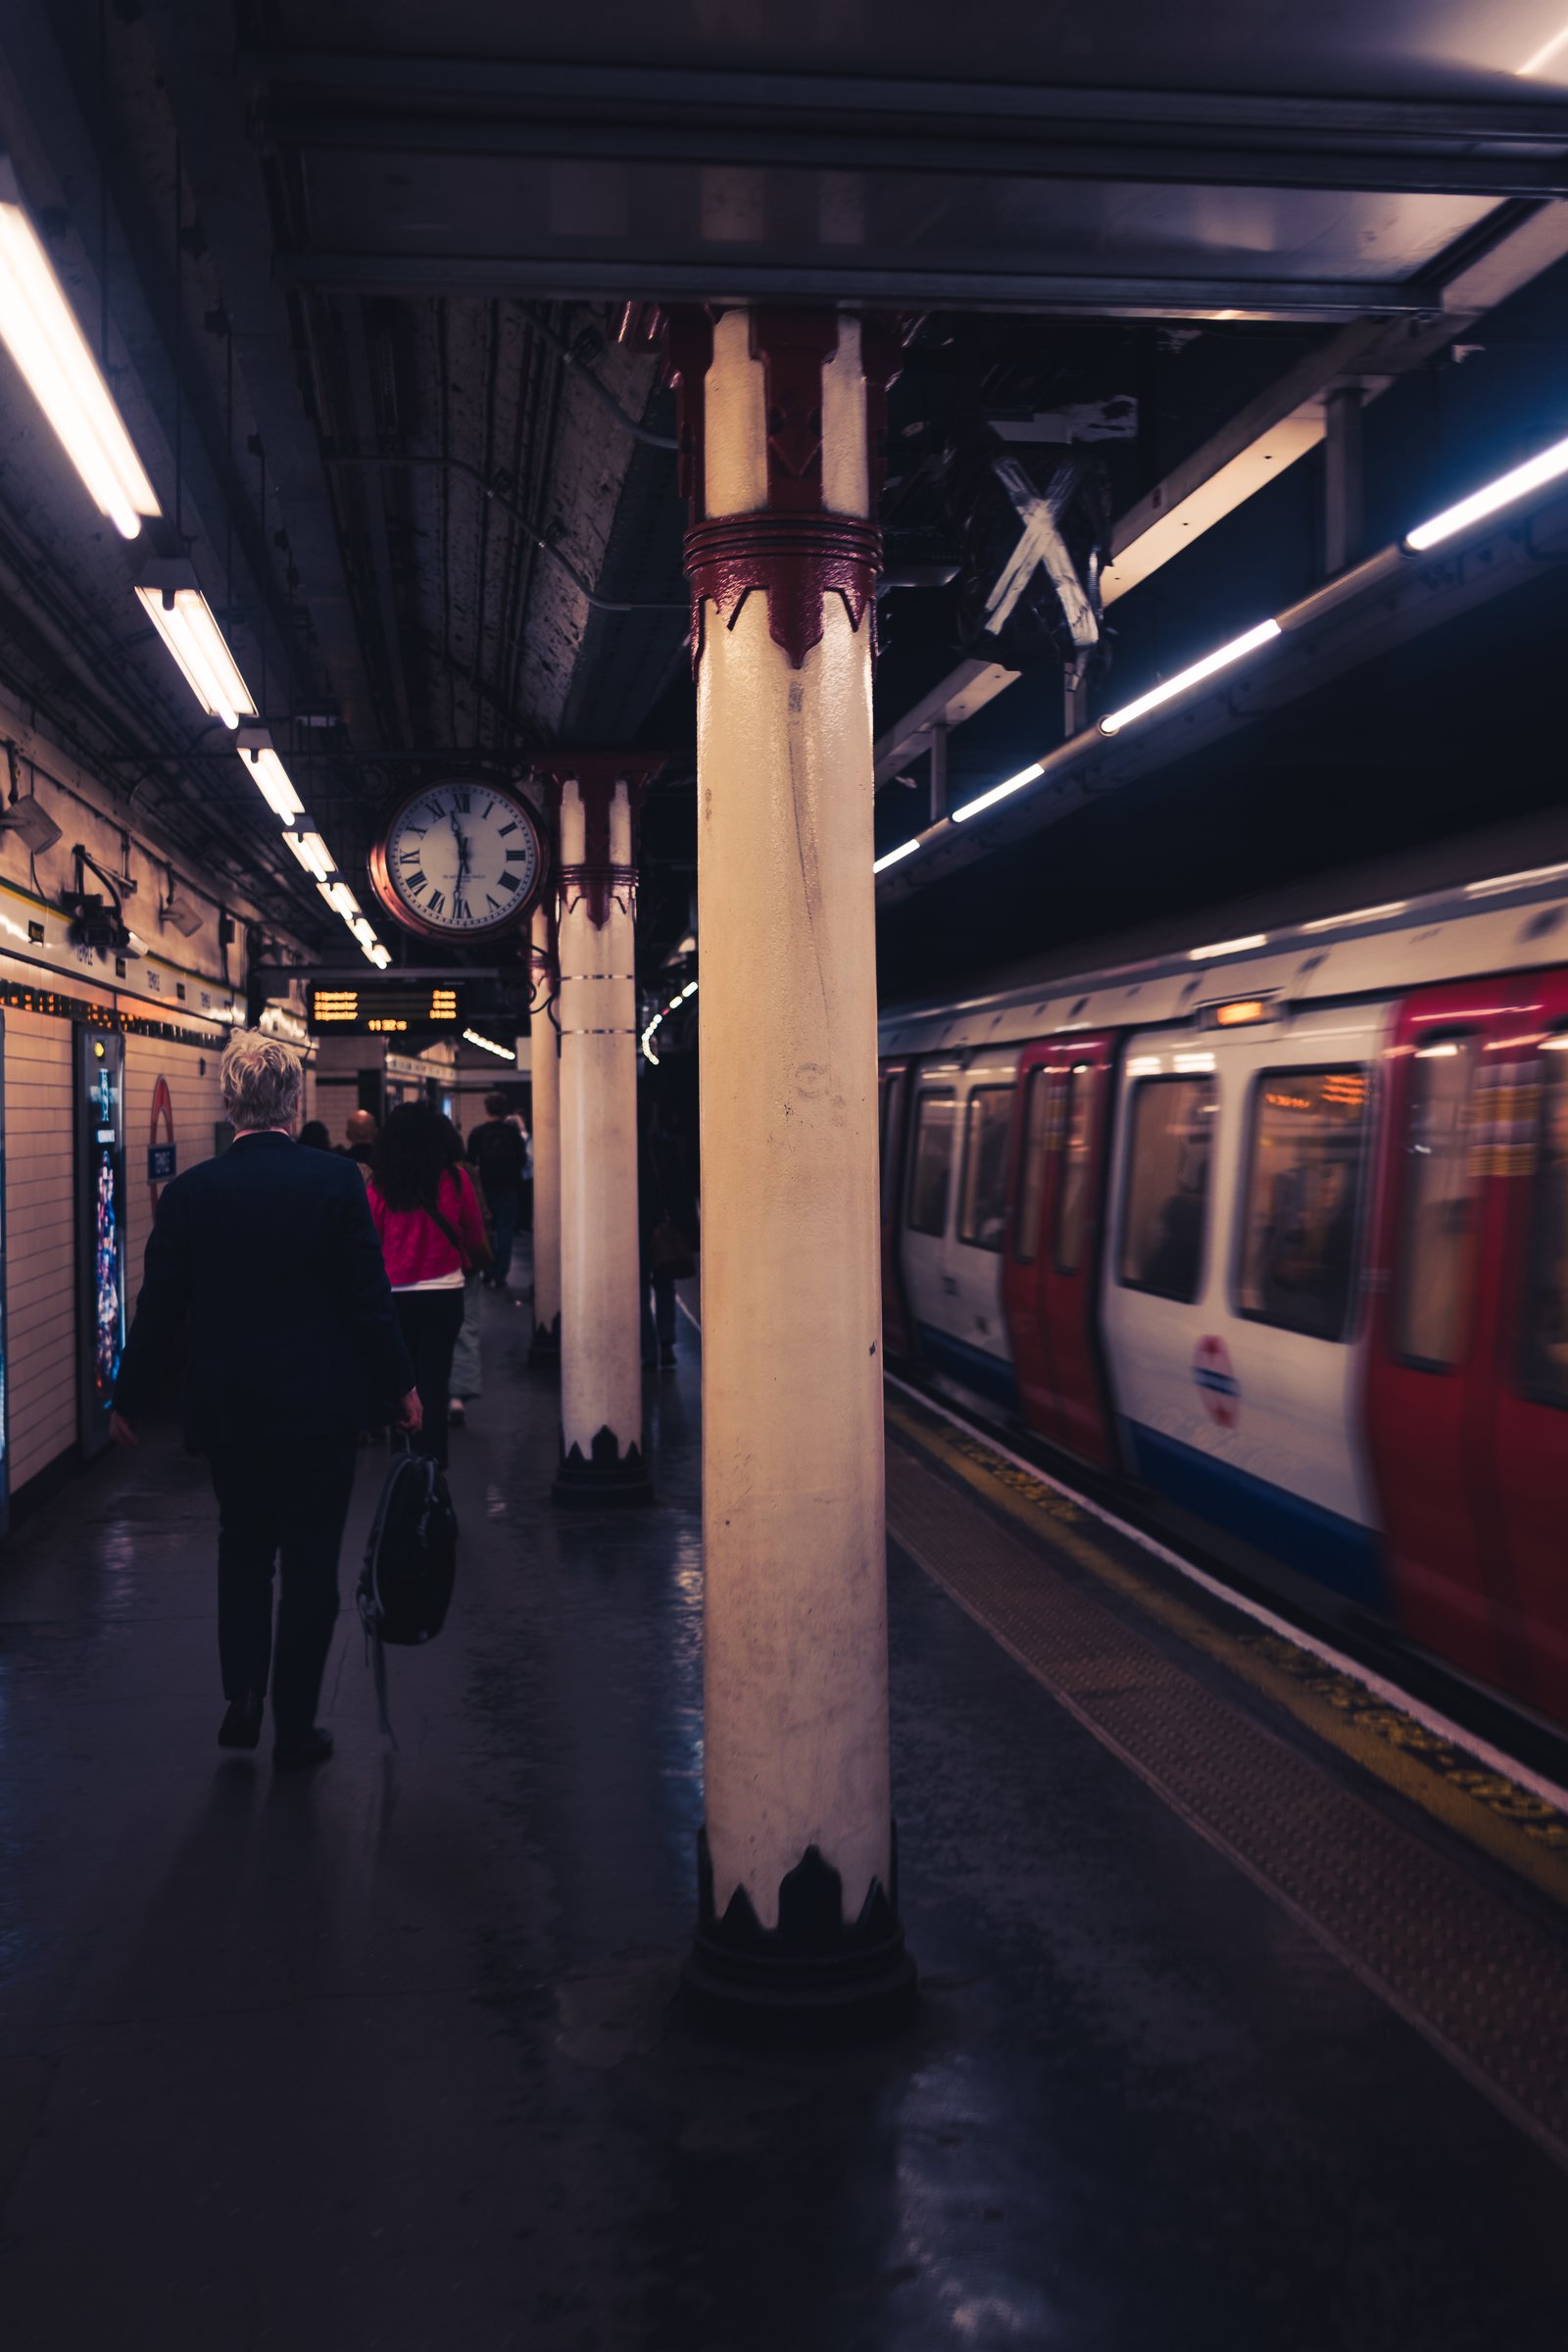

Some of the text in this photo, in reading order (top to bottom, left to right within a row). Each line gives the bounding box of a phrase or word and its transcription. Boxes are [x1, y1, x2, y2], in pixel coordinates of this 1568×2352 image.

[425, 798, 447, 823] XI
[453, 793, 471, 813] XII
[482, 801, 495, 819] I
[405, 820, 427, 841] X
[498, 821, 518, 837] II
[400, 849, 420, 864] IX
[506, 850, 526, 861] III
[405, 870, 429, 897] VIII
[426, 889, 446, 914] VII
[485, 893, 502, 914] V
[76, 945, 93, 966] TEMPLE
